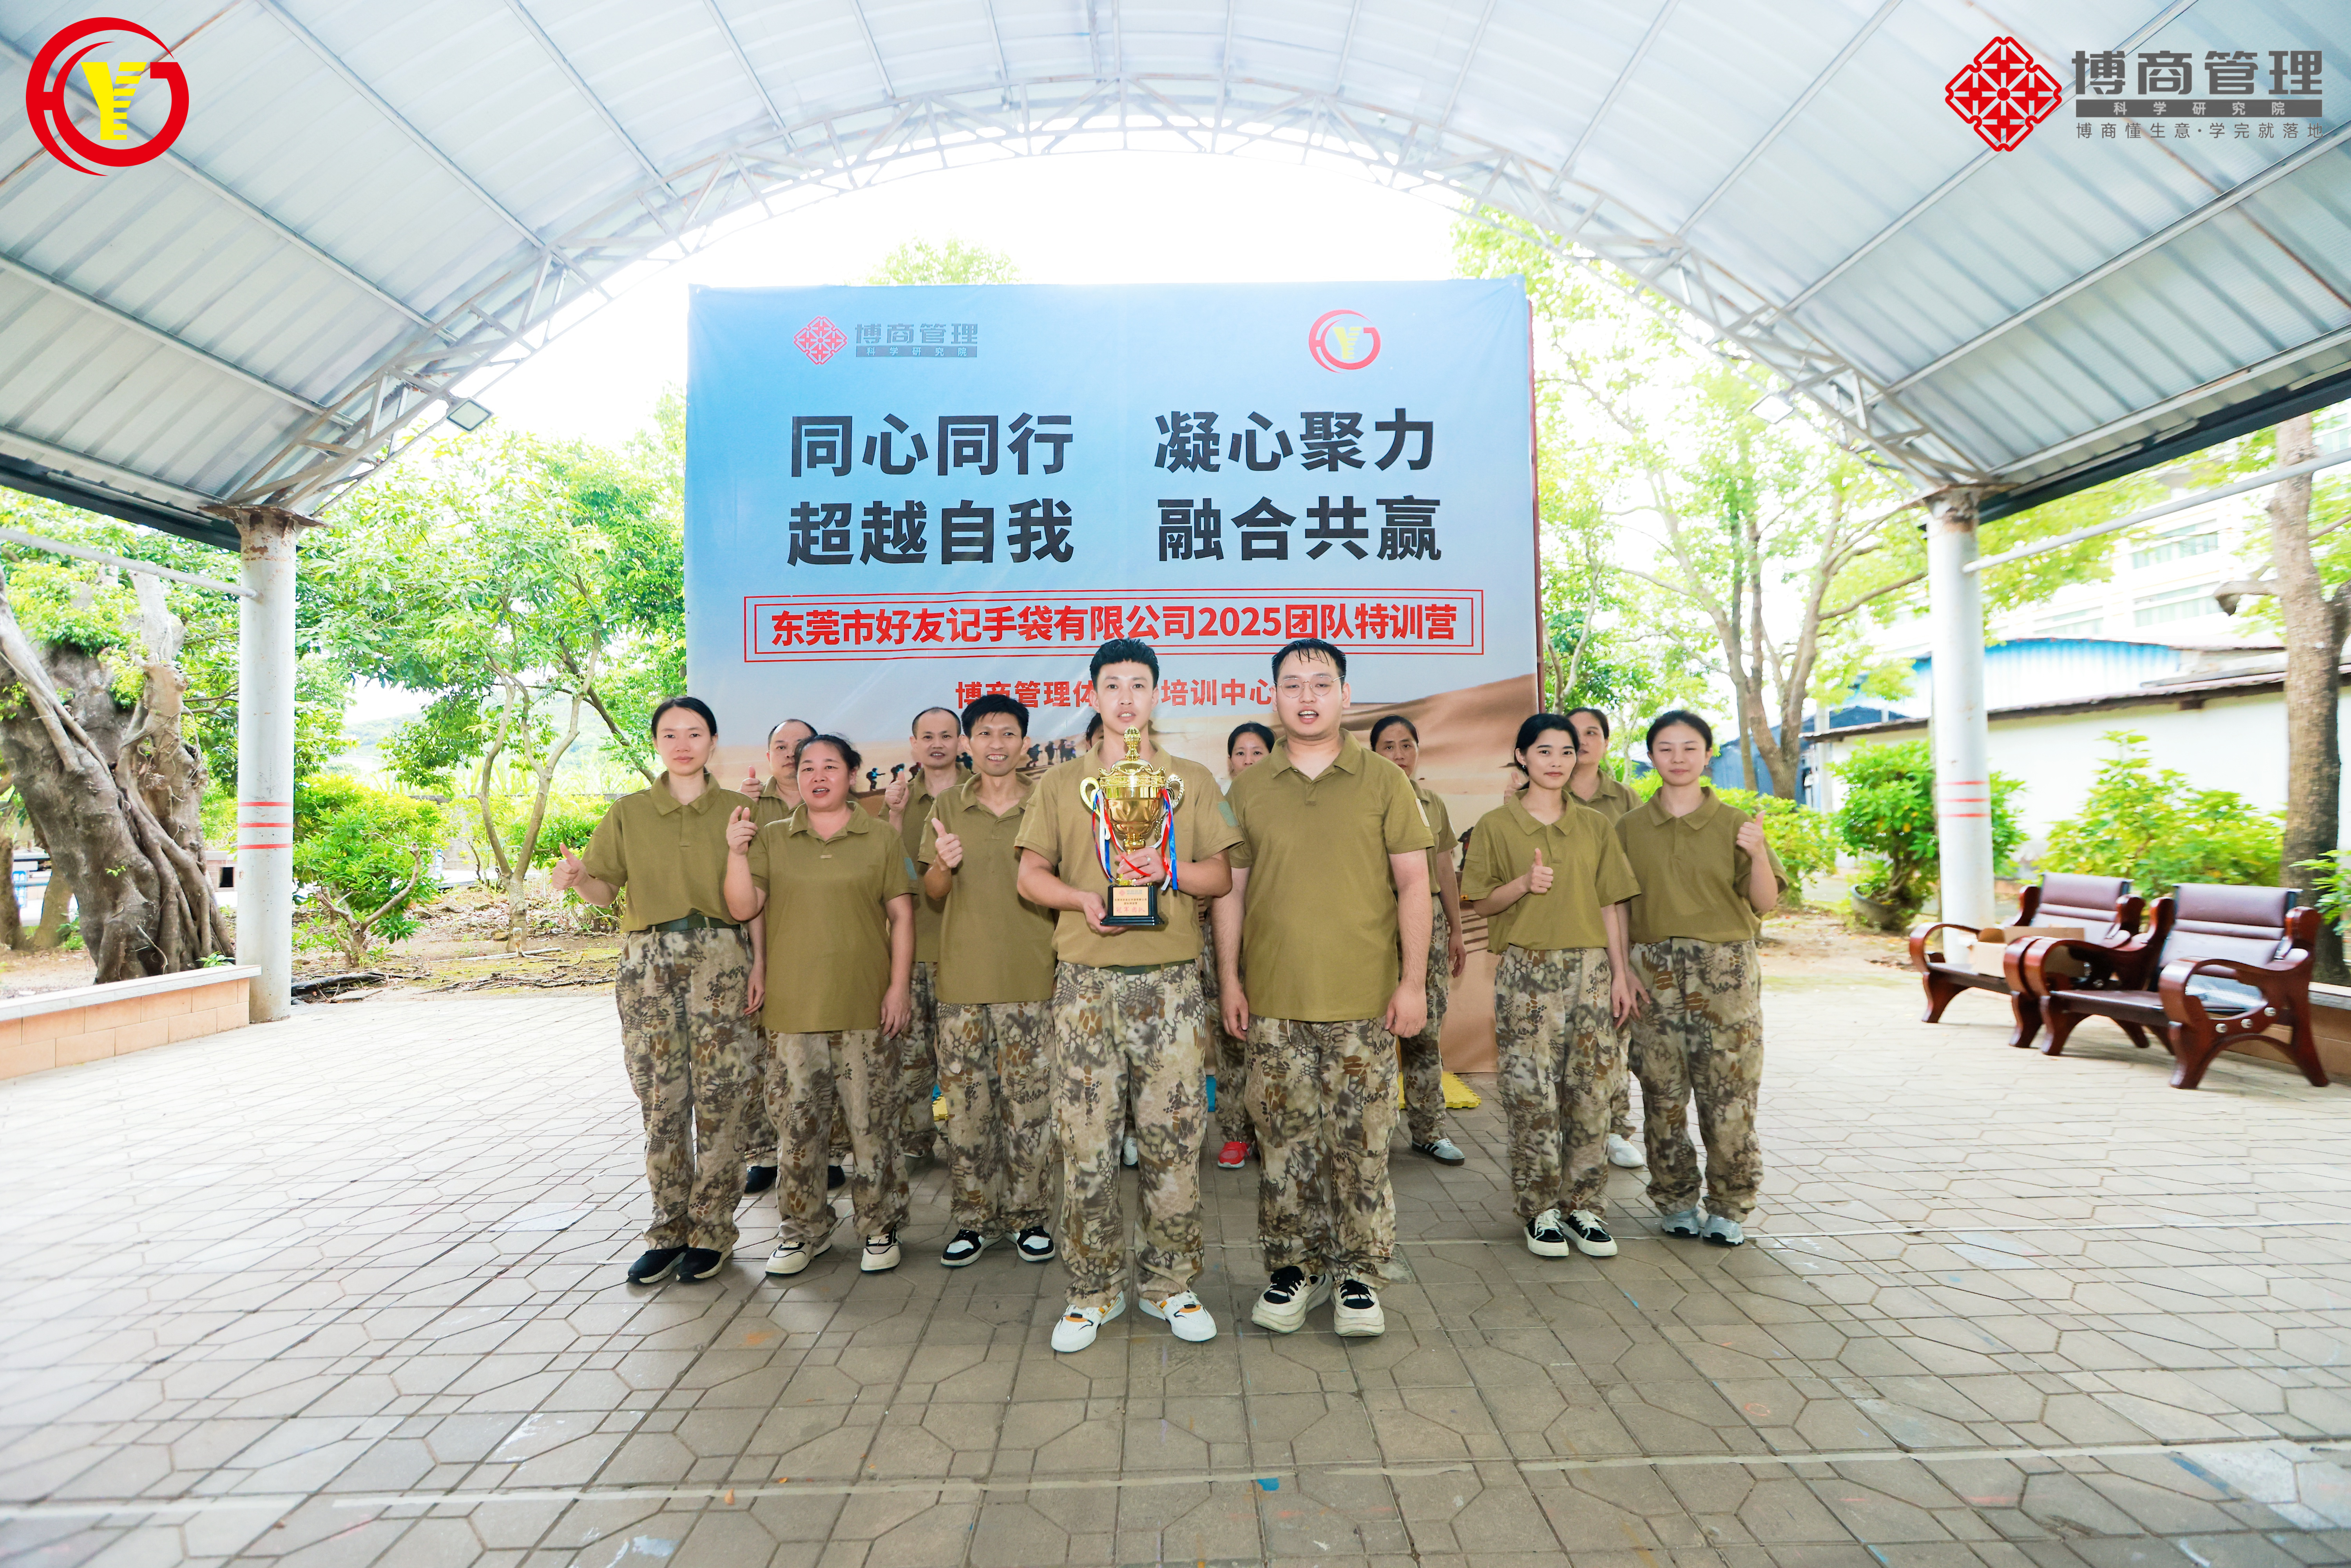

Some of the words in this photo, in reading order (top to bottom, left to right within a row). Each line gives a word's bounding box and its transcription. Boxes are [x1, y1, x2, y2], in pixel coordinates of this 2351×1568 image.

[855, 323, 978, 344] 博商管理
[866, 346, 967, 356] 科学研究院
[792, 413, 1073, 477] 同心同行
[1154, 408, 1433, 473] 凝心聚力
[787, 498, 1074, 567] 超越自我
[1158, 495, 1442, 561] 融合共赢
[772, 603, 1457, 646] 东莞市好友记手袋有限公司2025团队特训营
